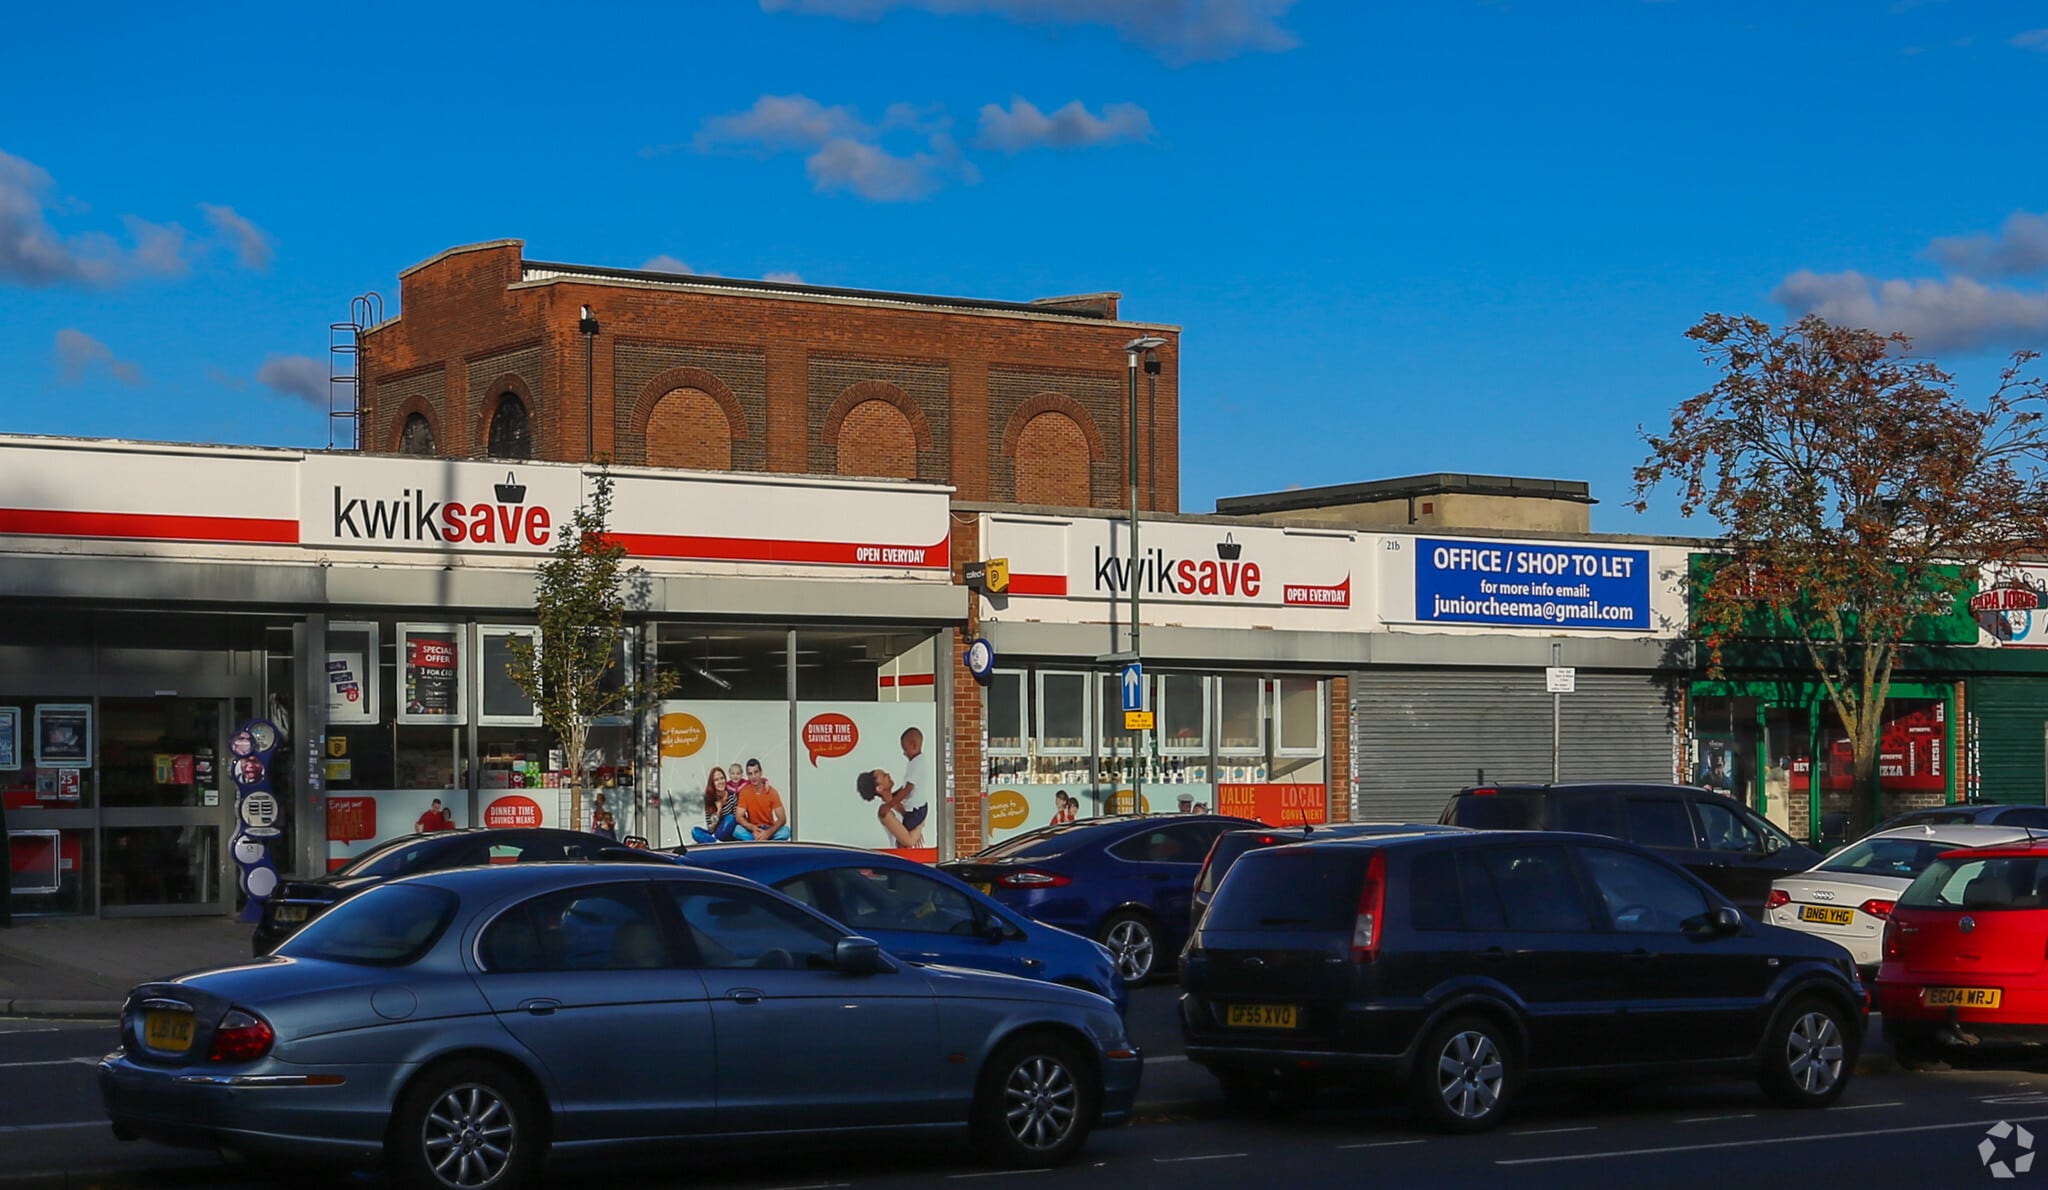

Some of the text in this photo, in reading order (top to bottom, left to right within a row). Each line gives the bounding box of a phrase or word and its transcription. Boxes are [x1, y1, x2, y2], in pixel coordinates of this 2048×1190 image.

[333, 484, 551, 546] kwiksave
[1385, 540, 1401, 552] 21b
[856, 547, 925, 564] OPEN EVERYDAY
[1433, 547, 1634, 578] OFFICE / SHOP TO LET
[1095, 545, 1261, 597] kwiksave
[1286, 587, 1346, 604] OPEN EVERYDAY
[1480, 579, 1590, 598] for more info email:
[1432, 594, 1634, 622] juniorcheema@gmail.com
[1972, 591, 2000, 609] PAPA
[423, 645, 453, 655] SPECIAL
[425, 654, 450, 664] OFFER
[808, 724, 851, 734] DINNER TIME
[808, 734, 852, 743] SAVINGS MEANS
[1879, 765, 1904, 777] IZZA
[1220, 787, 1256, 805] VALUE
[1281, 787, 1323, 807] LOCAL
[490, 806, 535, 816] DINNER TIME
[1220, 805, 1256, 820] CHOICE
[490, 816, 535, 825] SAVINGS MEANS
[1806, 908, 1849, 922] DN61 YHG
[1930, 990, 1996, 1005] EG04 WRJ
[1232, 1006, 1291, 1025] GF55 XVO
